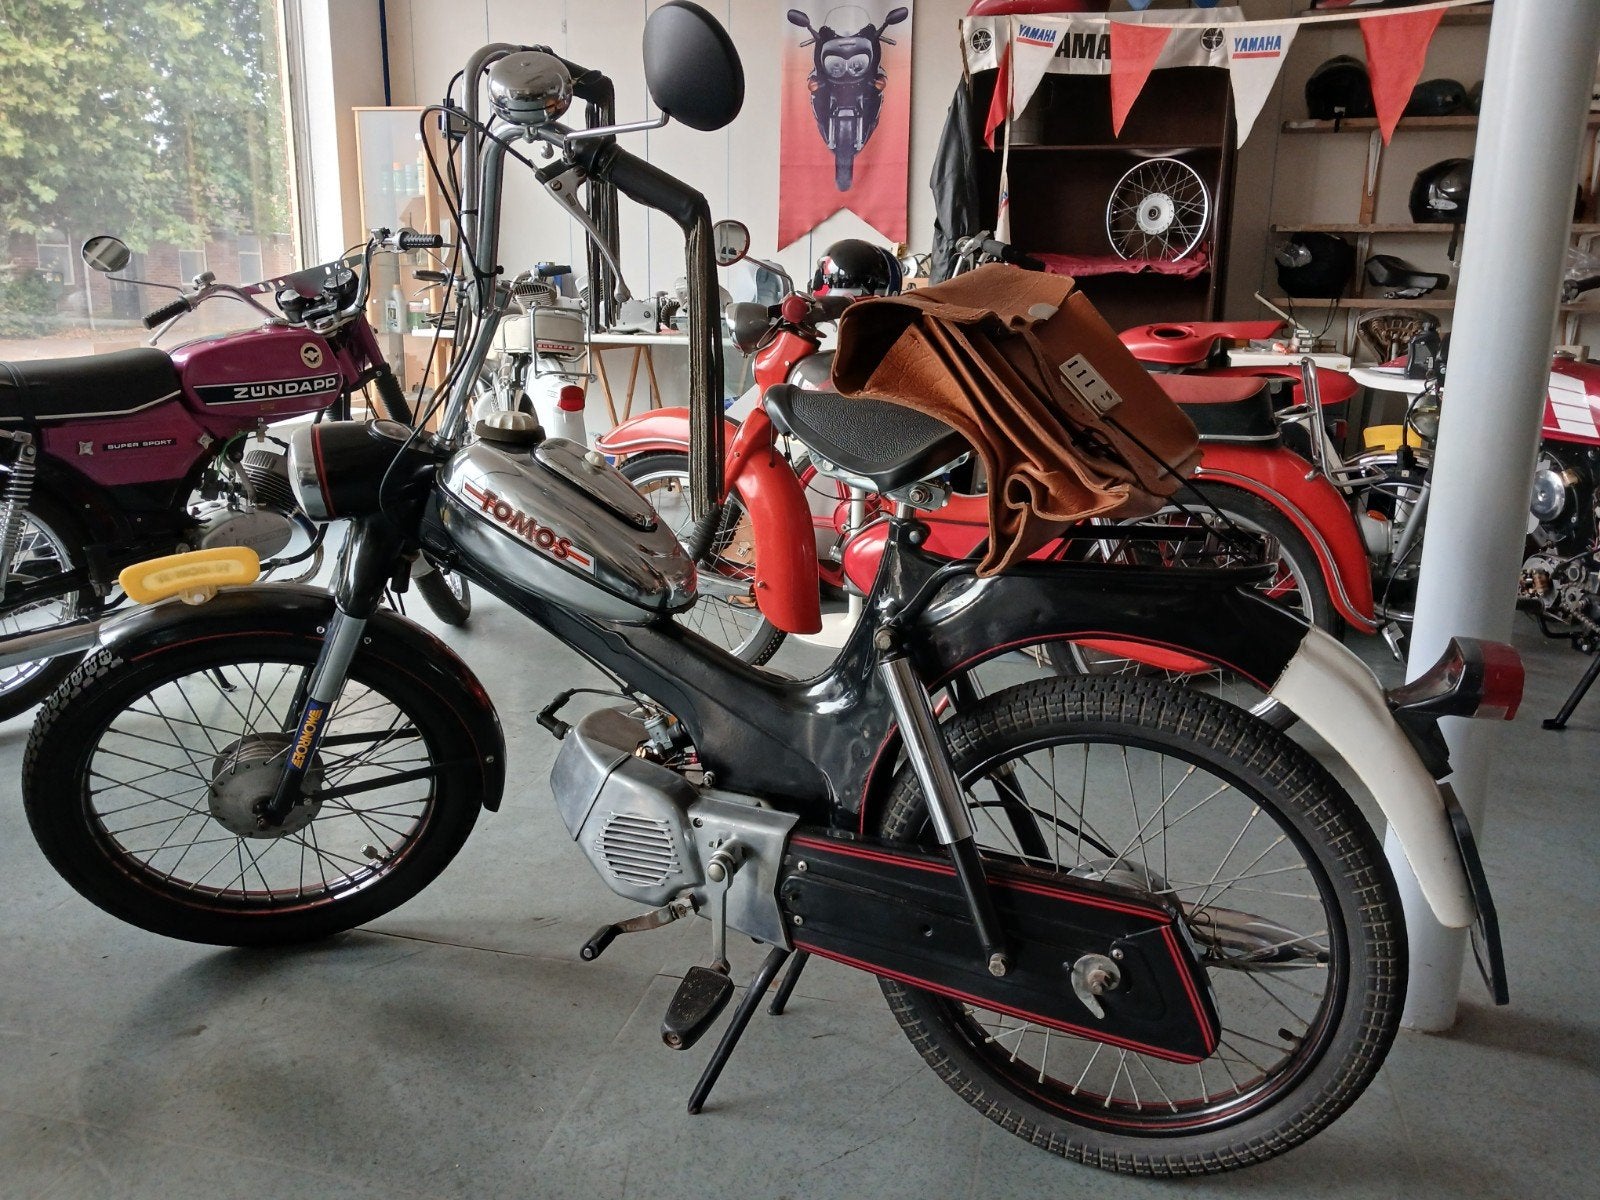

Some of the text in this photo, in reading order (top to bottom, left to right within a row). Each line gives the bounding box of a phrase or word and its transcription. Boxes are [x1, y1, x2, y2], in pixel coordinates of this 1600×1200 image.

[1018, 24, 1057, 42] YAMAHA
[1234, 35, 1281, 52] YAMAHA
[1054, 32, 1111, 60] AMA
[107, 439, 172, 450] SUPER SPORT
[480, 488, 572, 560] TOMOS
[291, 709, 323, 769] MONROE
